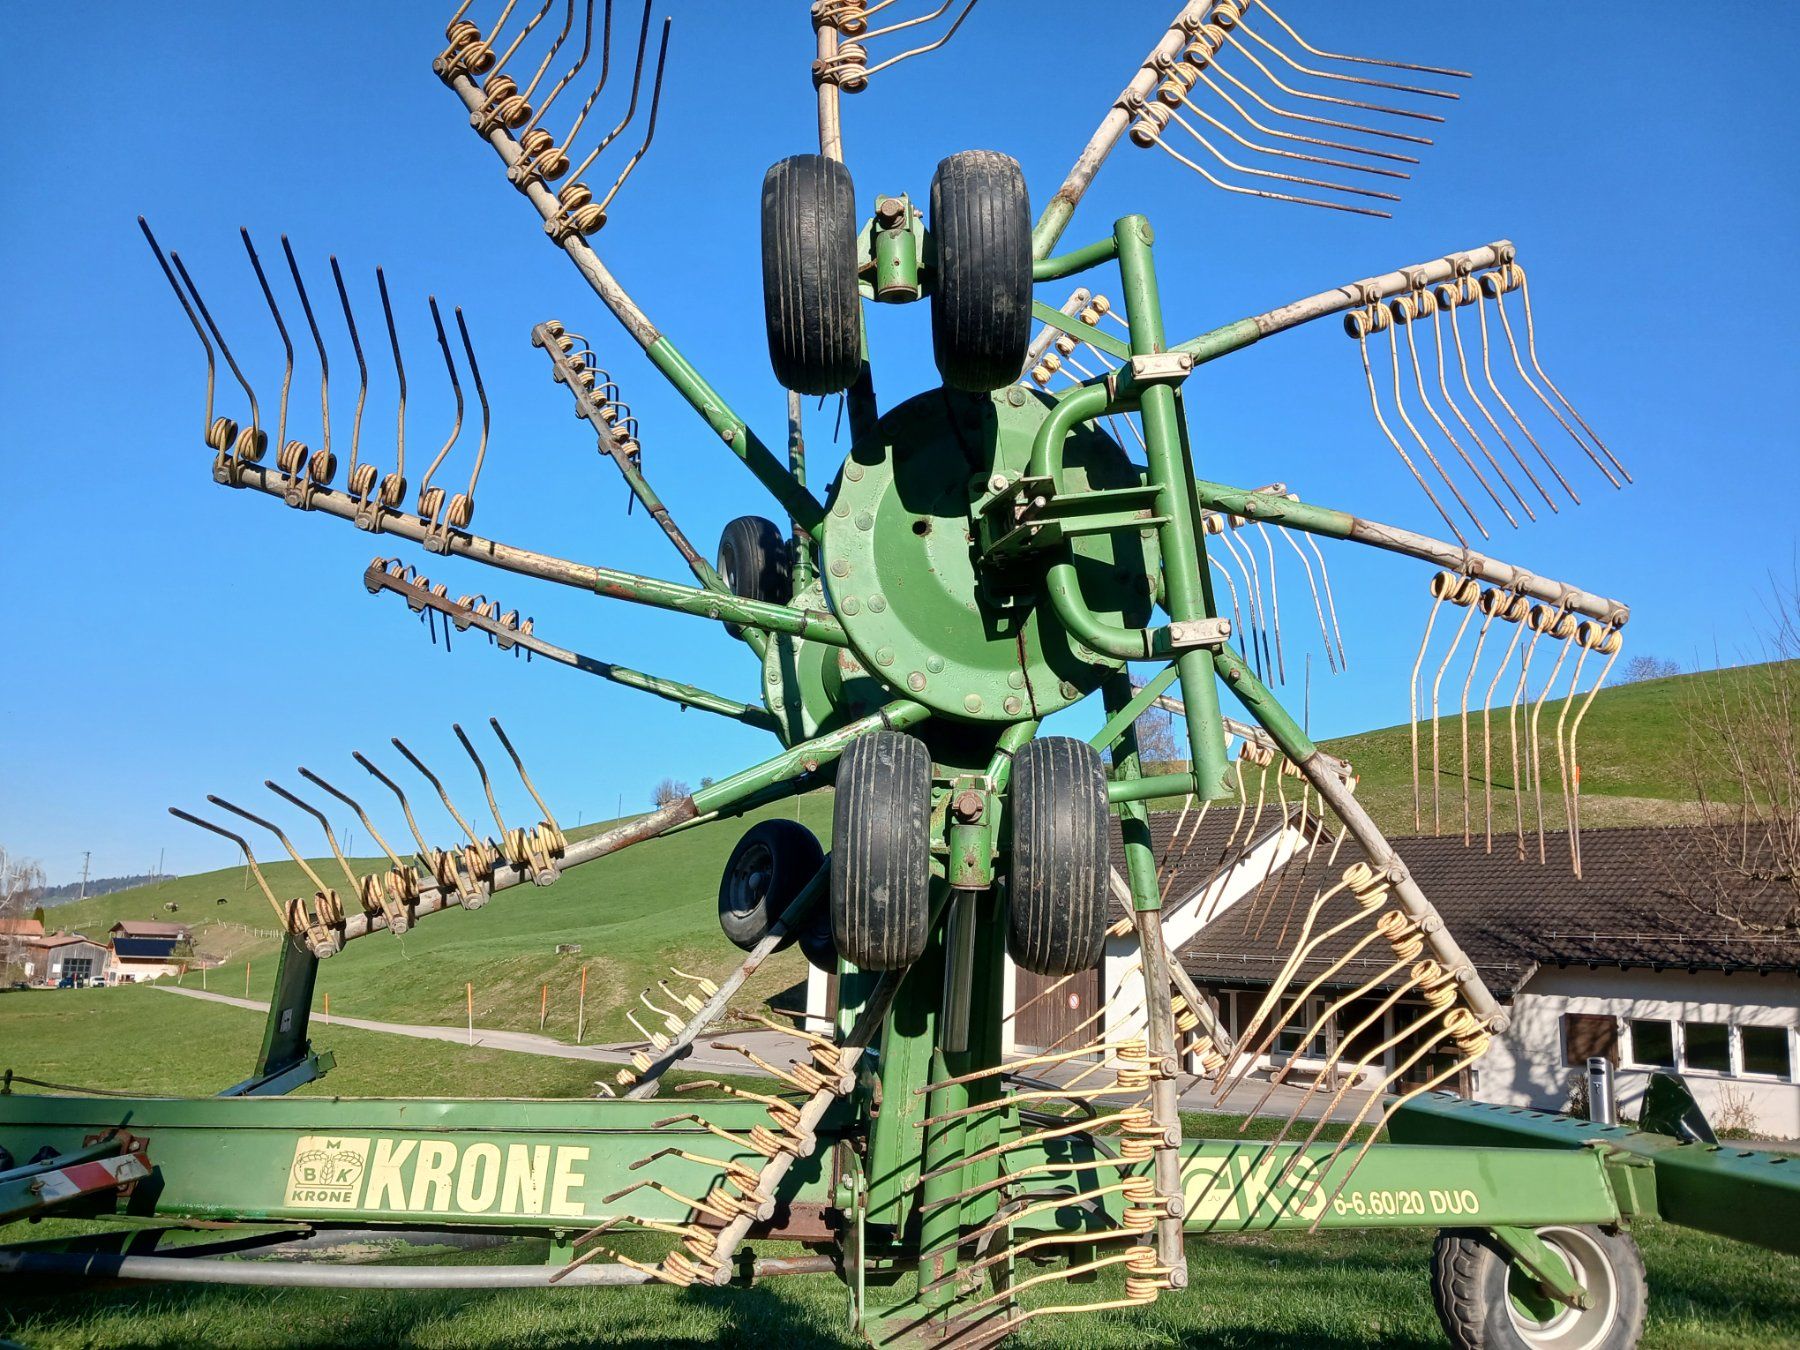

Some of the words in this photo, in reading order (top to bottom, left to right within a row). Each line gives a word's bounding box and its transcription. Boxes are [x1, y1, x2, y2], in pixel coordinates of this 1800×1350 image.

[326, 1140, 341, 1149] M
[304, 1168, 316, 1181] B
[336, 1168, 353, 1182] K
[364, 1138, 590, 1216] KRONE
[1238, 1155, 1327, 1220] KS
[1334, 1191, 1425, 1215] 6-6.60/20
[1429, 1190, 1479, 1214] DUO
[292, 1190, 352, 1202] KRONE
